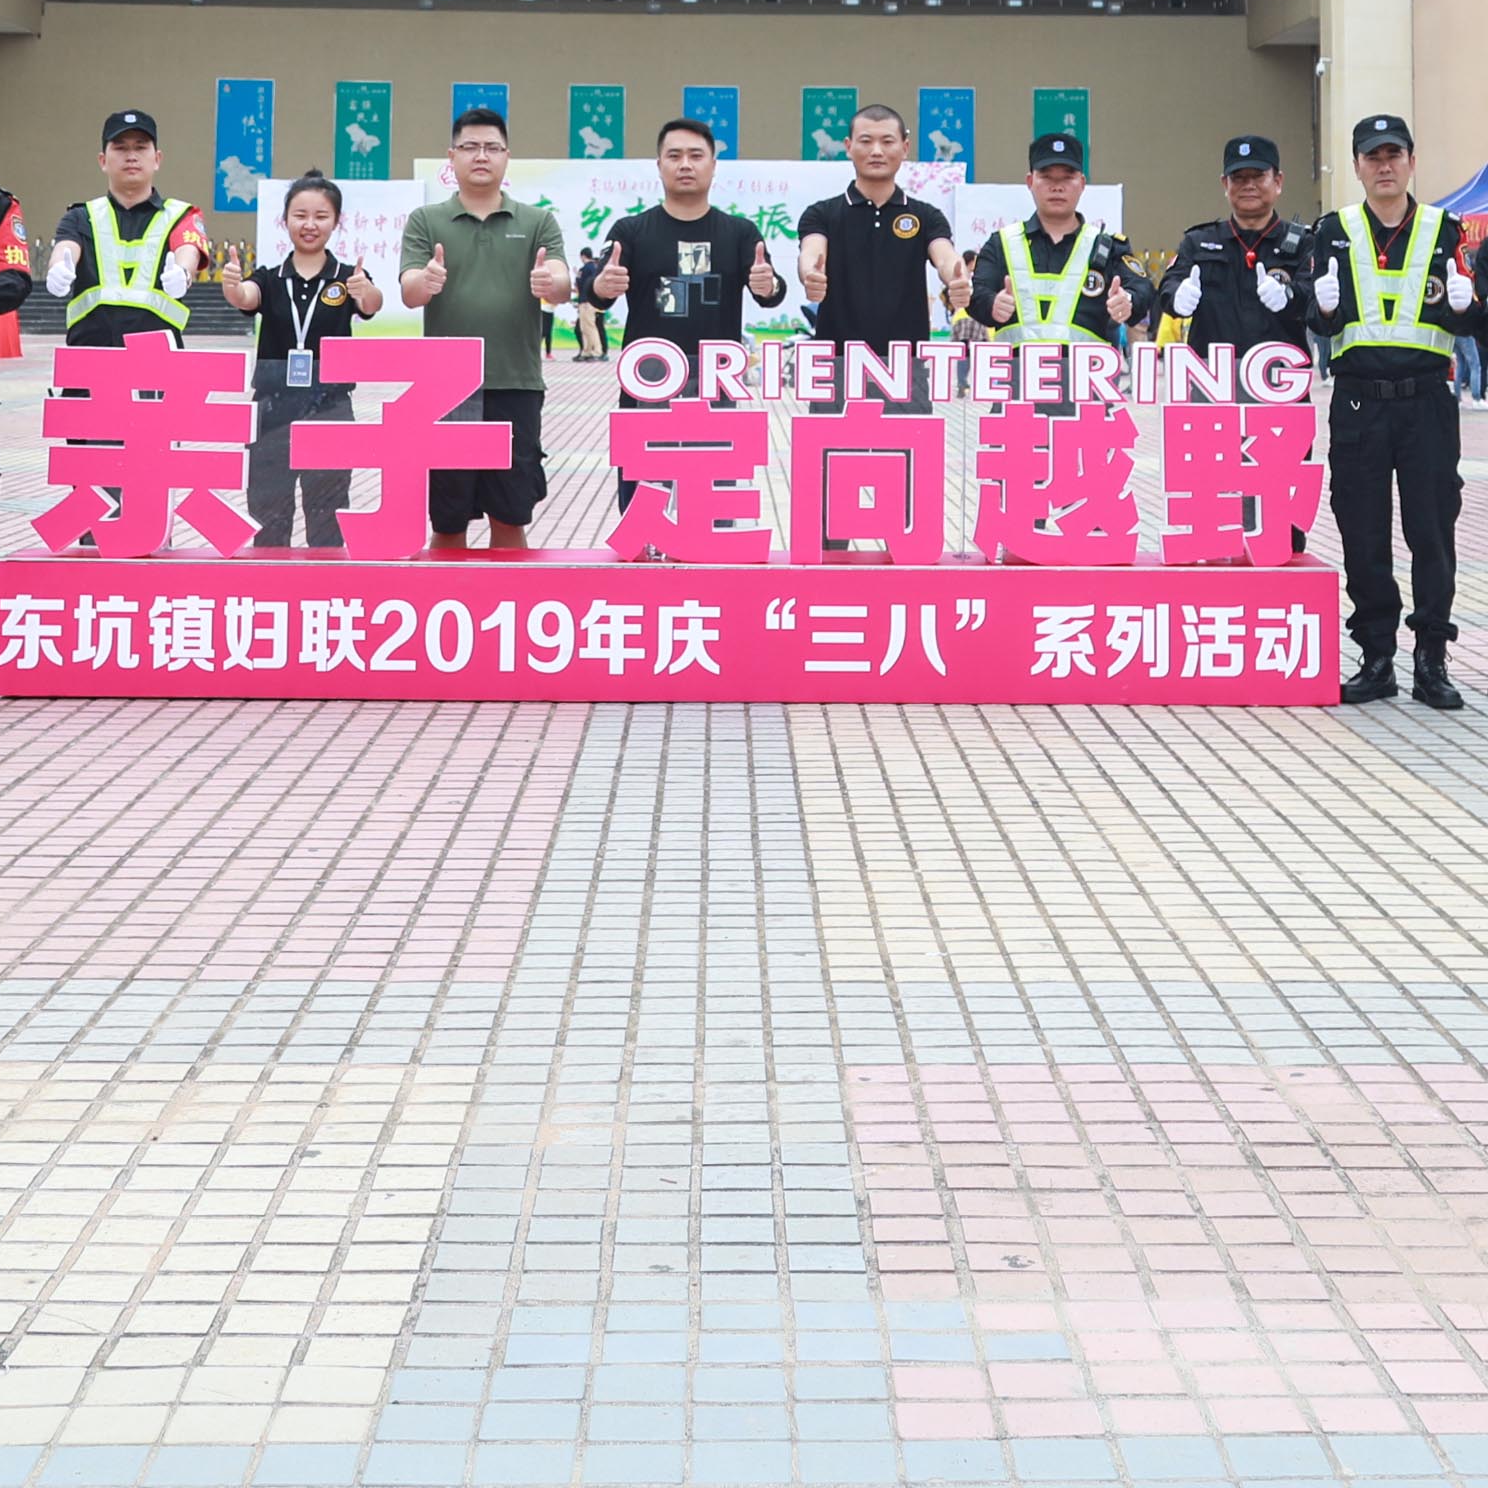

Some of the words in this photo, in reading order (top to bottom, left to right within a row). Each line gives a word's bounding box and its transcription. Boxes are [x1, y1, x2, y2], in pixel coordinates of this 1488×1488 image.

[615, 336, 1316, 405] ORIENTEERING
[29, 329, 515, 560] 亲子
[605, 399, 1327, 568] 定向越野
